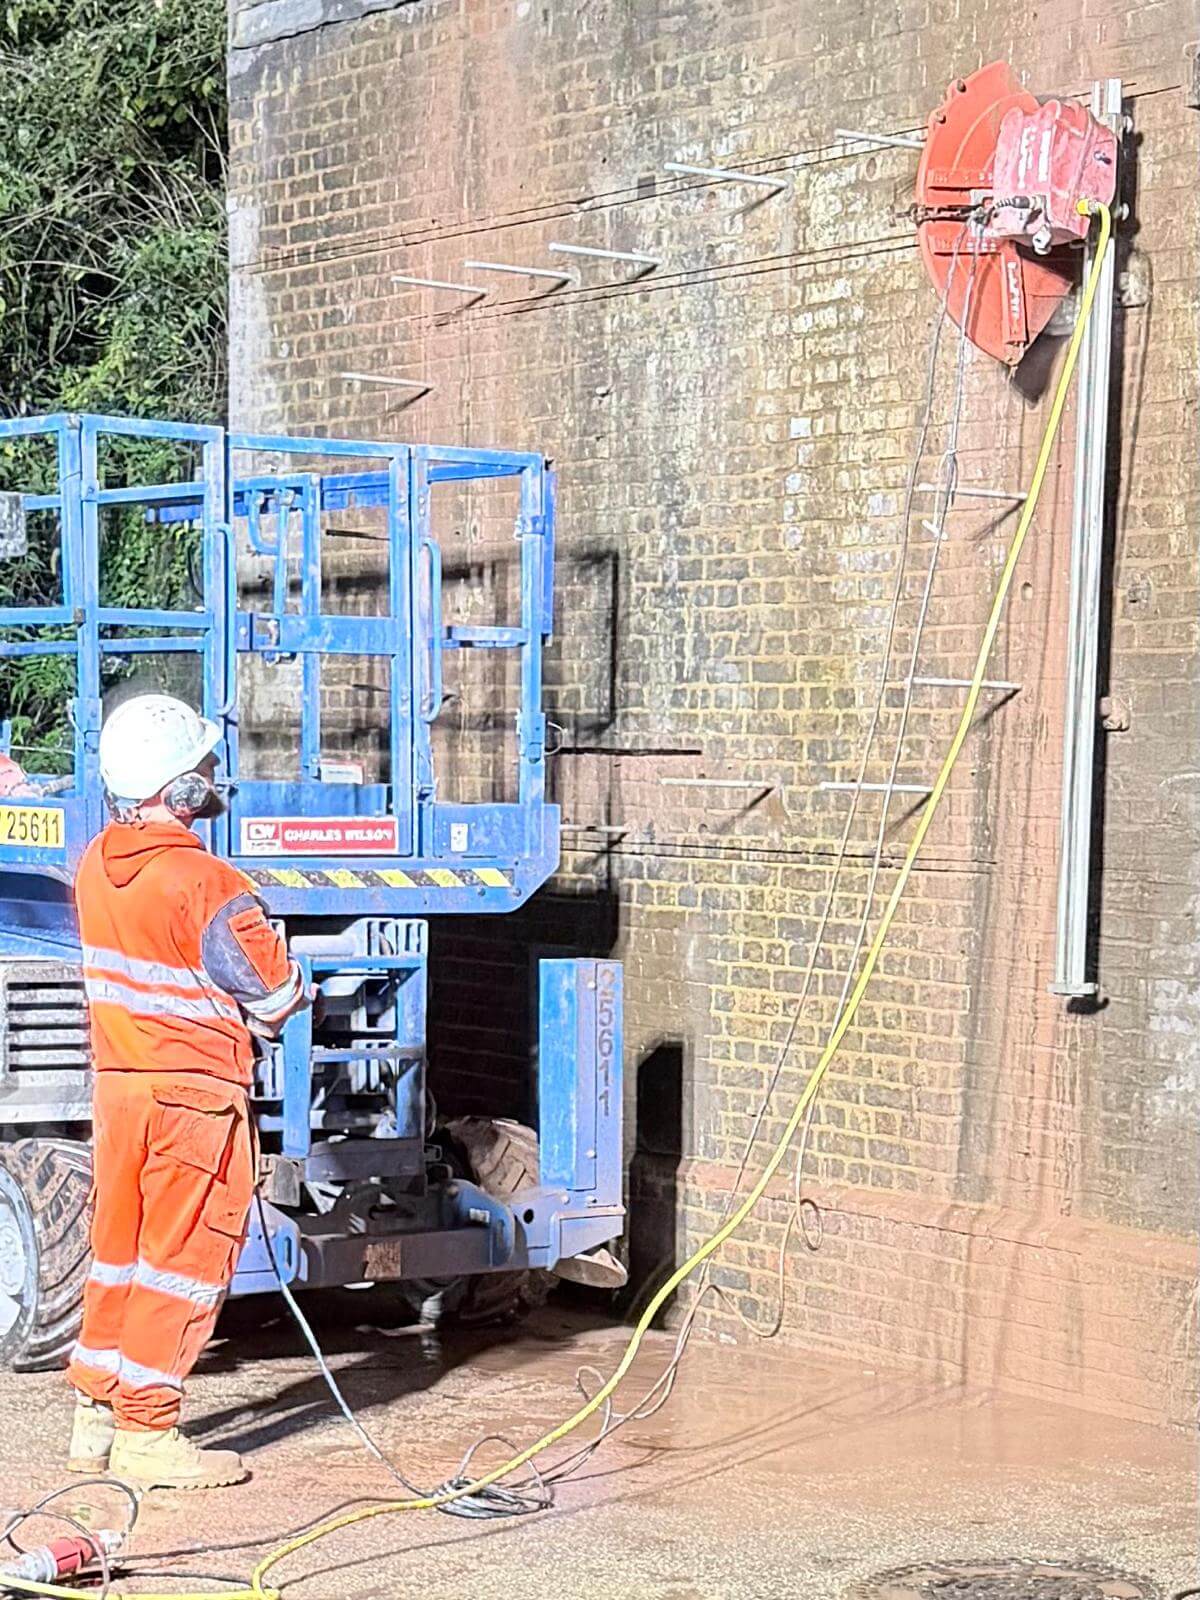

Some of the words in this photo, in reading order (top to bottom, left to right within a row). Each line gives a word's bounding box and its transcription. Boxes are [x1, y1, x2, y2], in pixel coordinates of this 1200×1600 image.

[7, 811, 59, 844] 25611
[284, 828, 342, 842] CHARLES
[345, 828, 393, 842] WILSON
